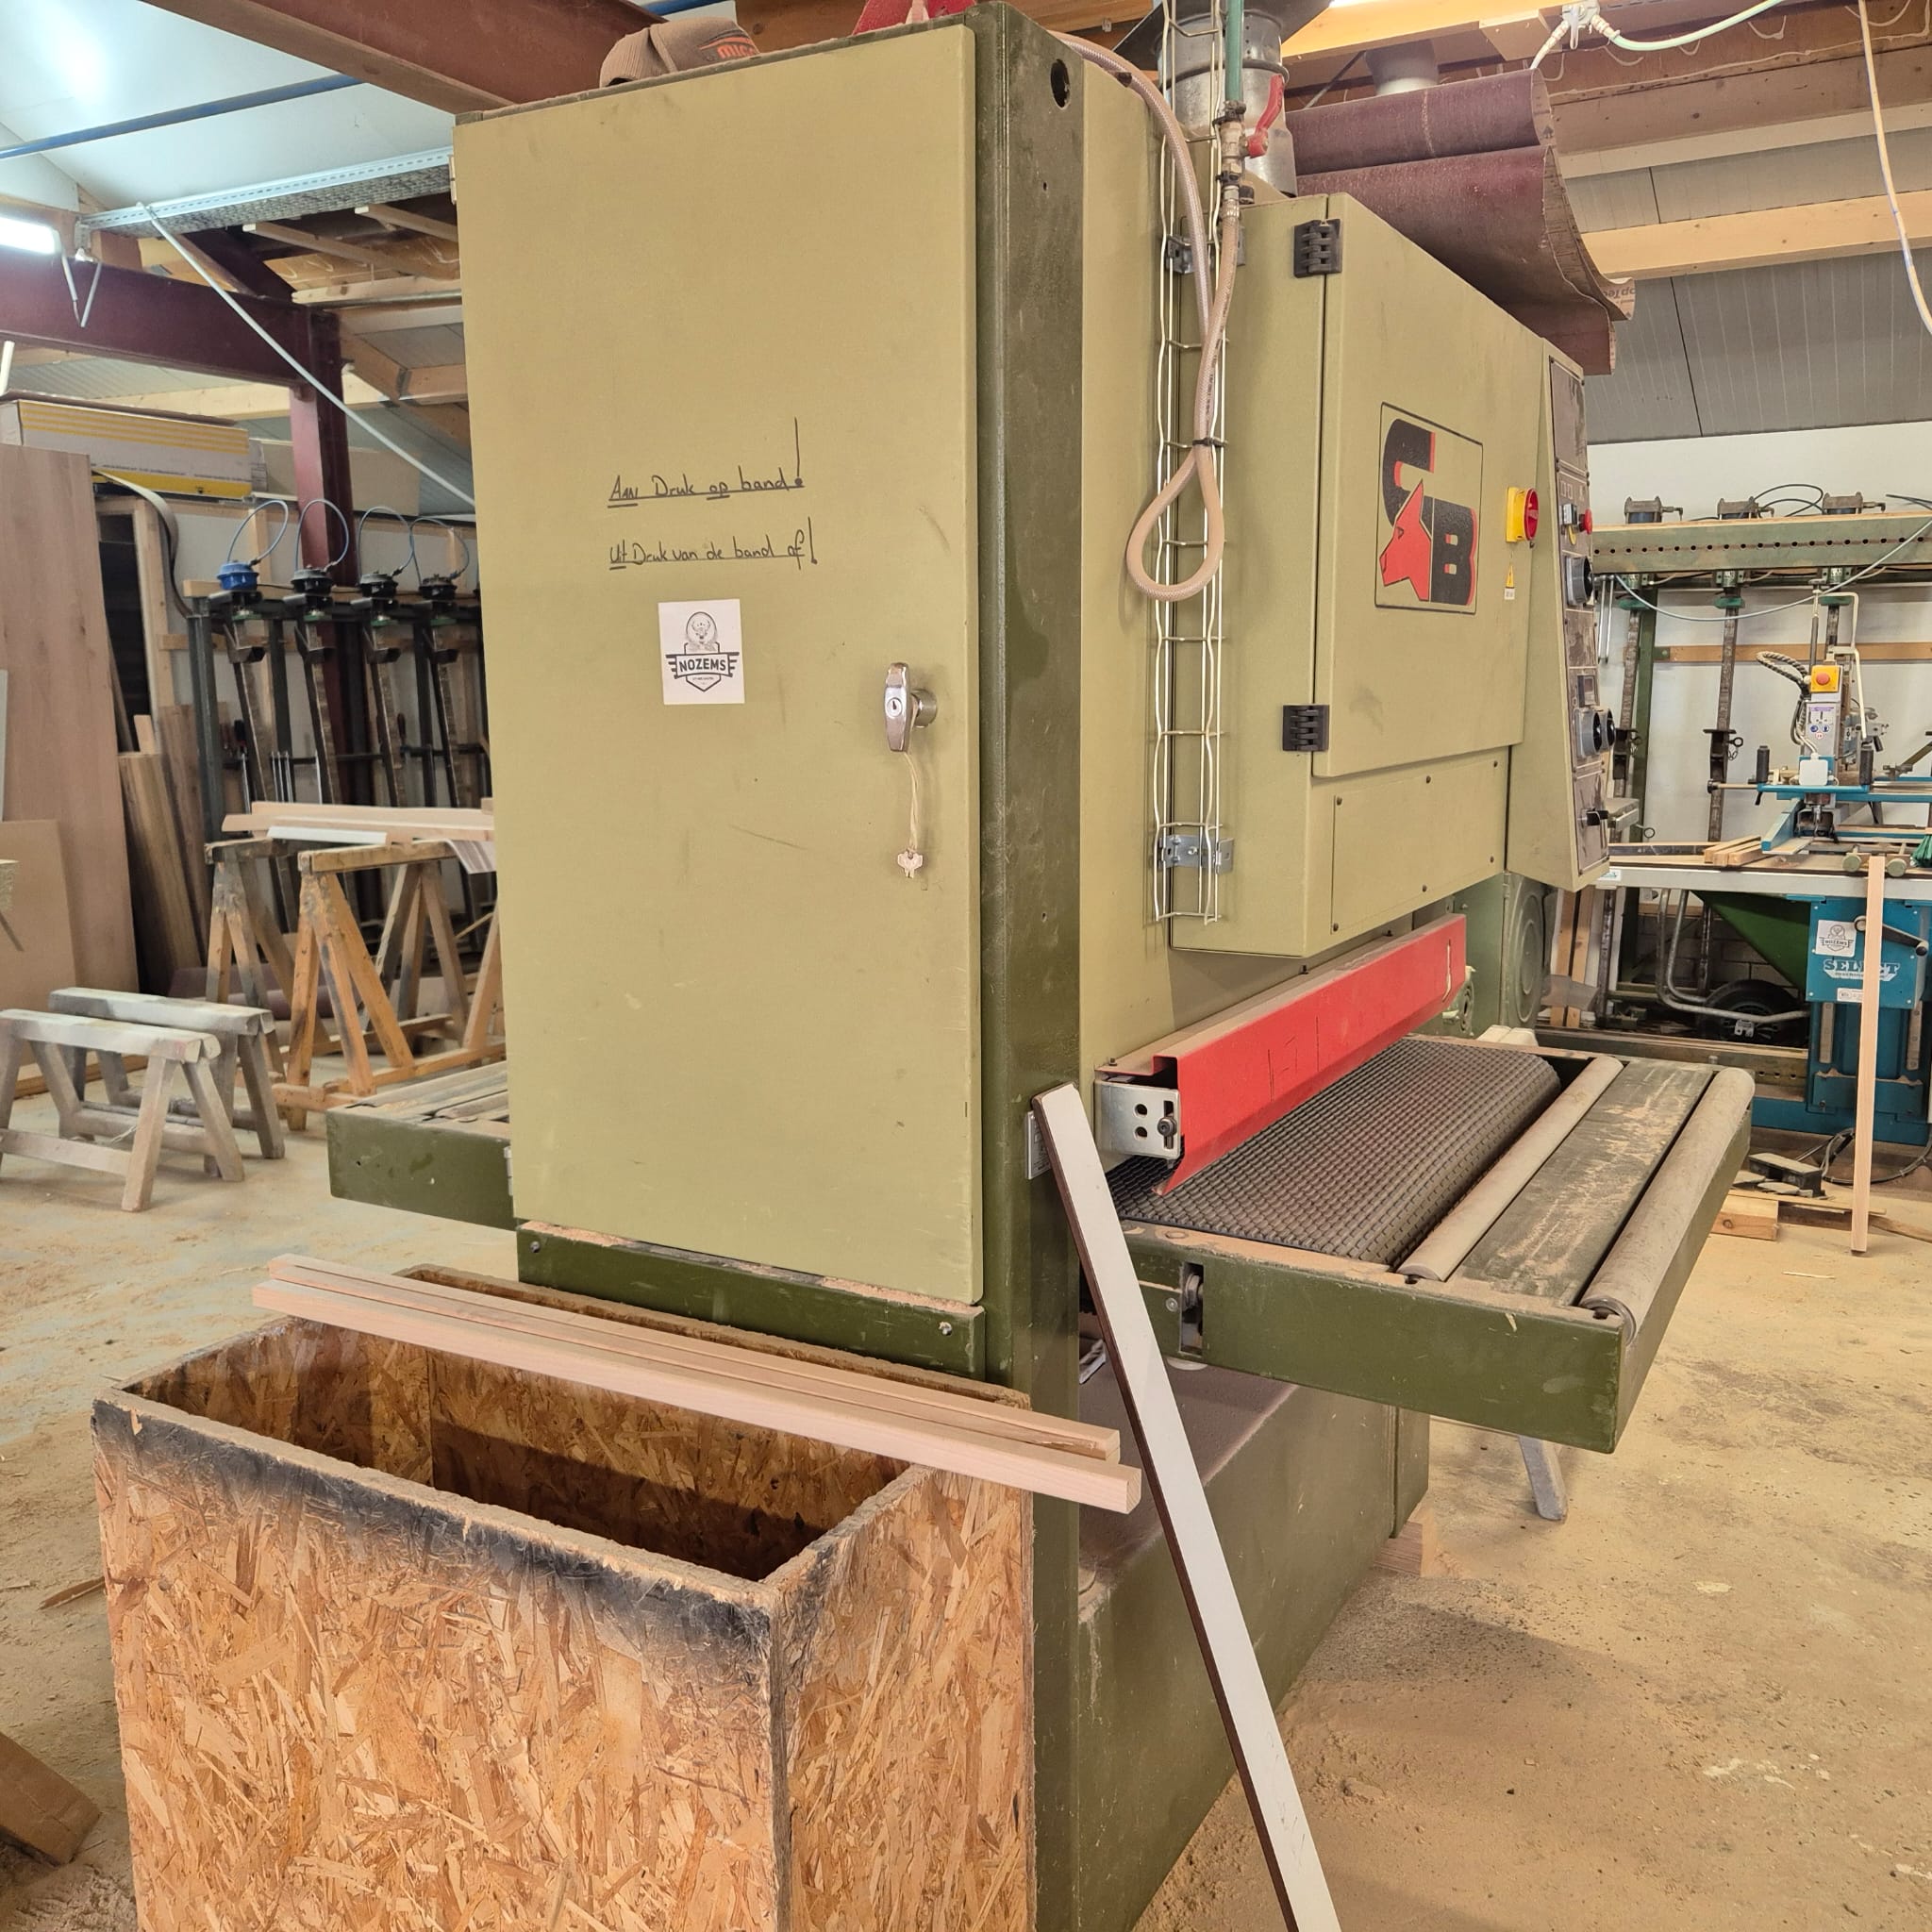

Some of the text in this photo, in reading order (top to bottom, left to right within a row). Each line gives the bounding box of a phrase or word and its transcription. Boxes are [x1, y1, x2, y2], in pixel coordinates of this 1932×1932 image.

[651, 474, 694, 497] Druk
[708, 481, 728, 498] op
[632, 541, 668, 565] Druk
[672, 548, 699, 561] van
[708, 541, 723, 560] de
[733, 536, 774, 559] band
[678, 658, 726, 673] NOZEMS
[1824, 959, 1900, 974] SELT
